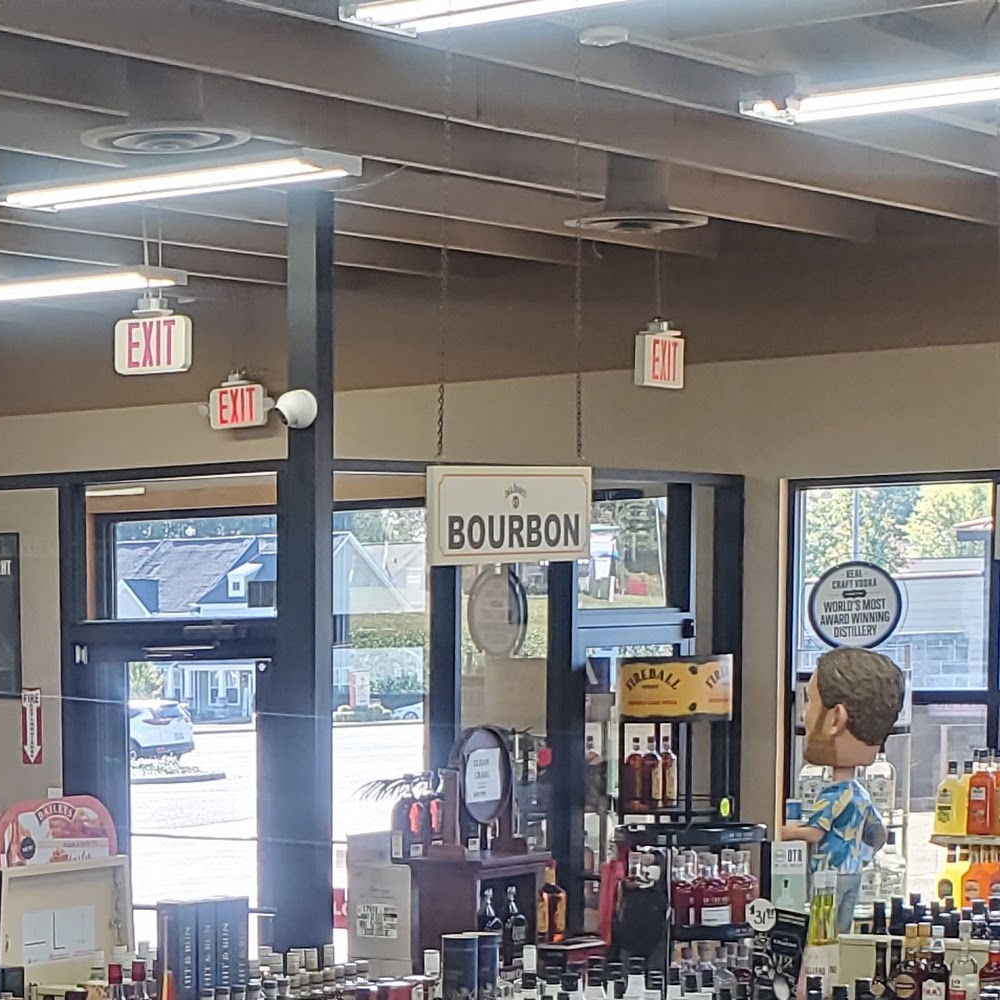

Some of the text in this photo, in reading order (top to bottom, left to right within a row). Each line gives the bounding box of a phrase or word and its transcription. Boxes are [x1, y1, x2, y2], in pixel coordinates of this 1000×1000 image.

[127, 318, 175, 369] EXIT
[651, 338, 679, 383] EXIT
[217, 386, 255, 424] EXIT
[448, 513, 579, 550] BOURBON
[832, 578, 877, 589] CRAFT VODKA
[823, 598, 885, 613] WORLD'S MOST
[820, 610, 890, 625] AWARD WINNING
[834, 625, 877, 638] DISTILLERY
[625, 668, 680, 691] FIREBALL
[23, 694, 39, 703] FIRE
[38, 802, 74, 818] BAILEYS
